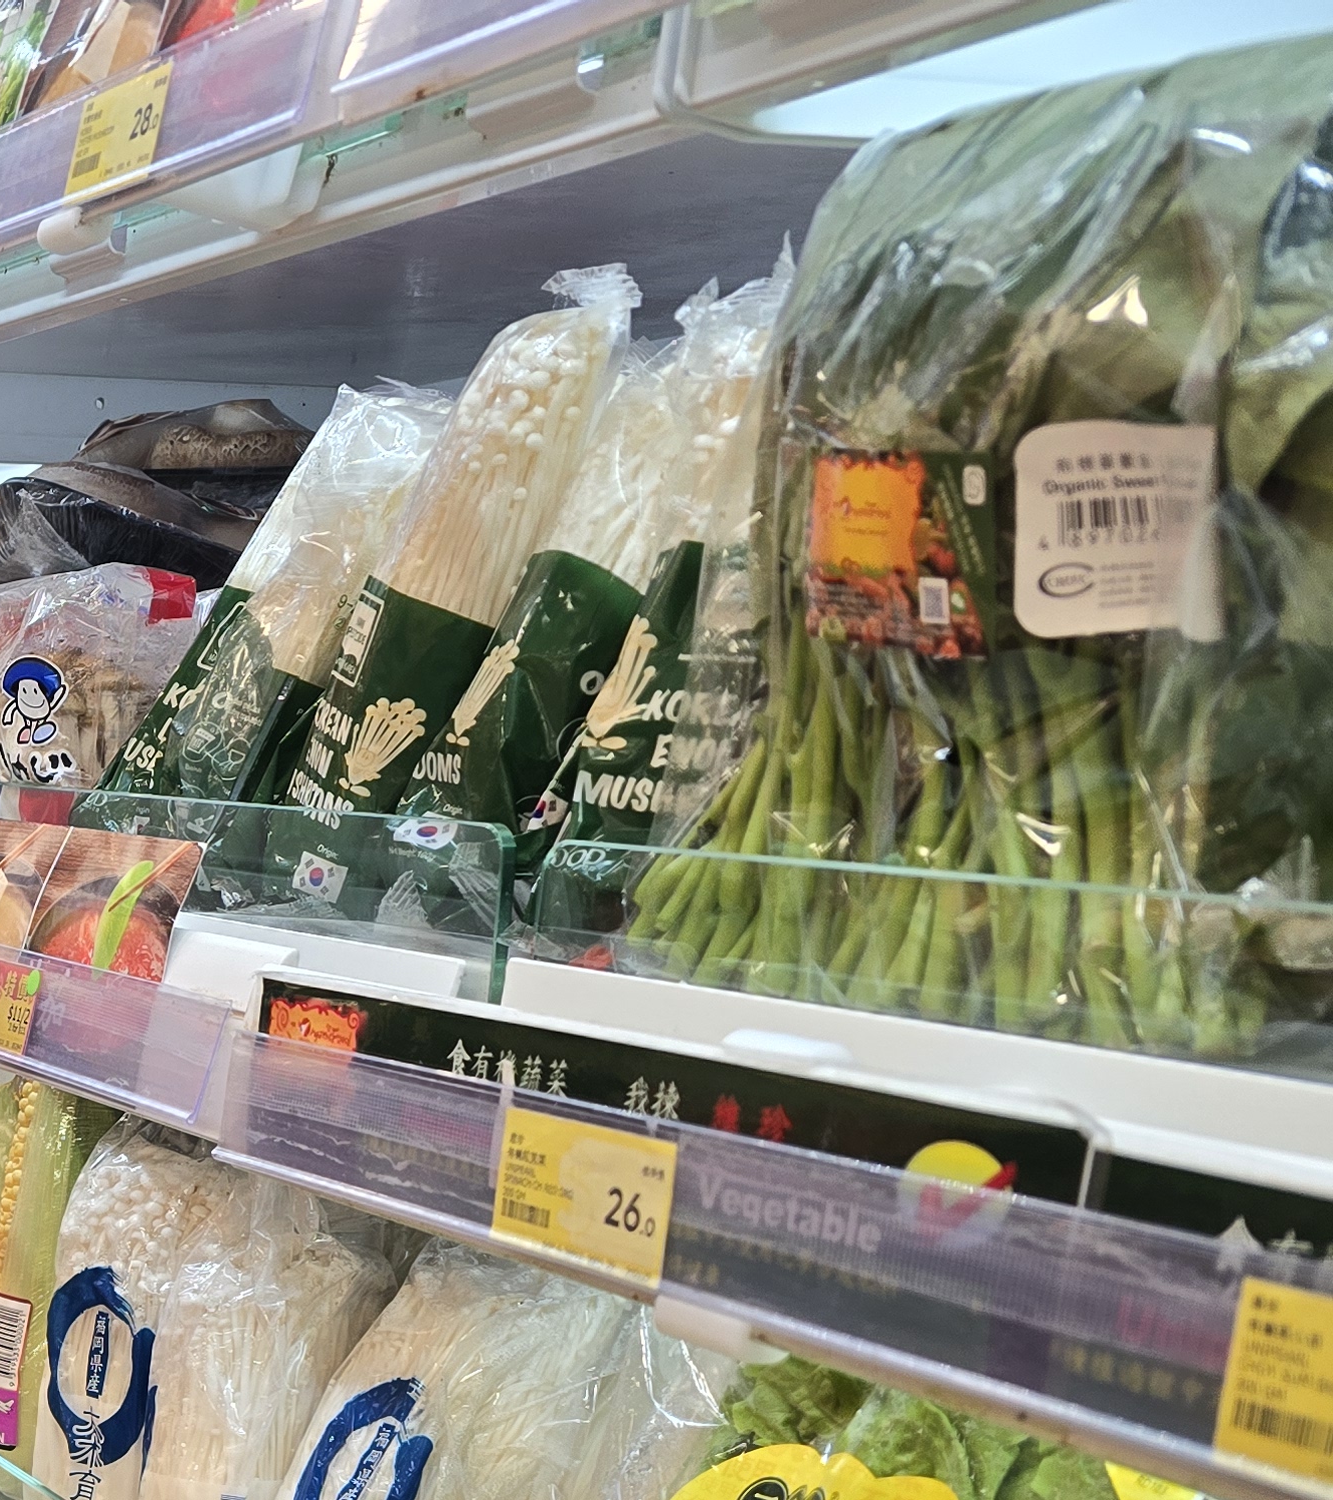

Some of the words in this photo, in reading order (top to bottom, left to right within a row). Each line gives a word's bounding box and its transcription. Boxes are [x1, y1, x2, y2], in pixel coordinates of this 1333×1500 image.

[129, 102, 160, 141] 28.0
[7, 1003, 31, 1025] $11/2
[604, 1187, 656, 1237] 26.0
[694, 1166, 882, 1256] Vegetable
